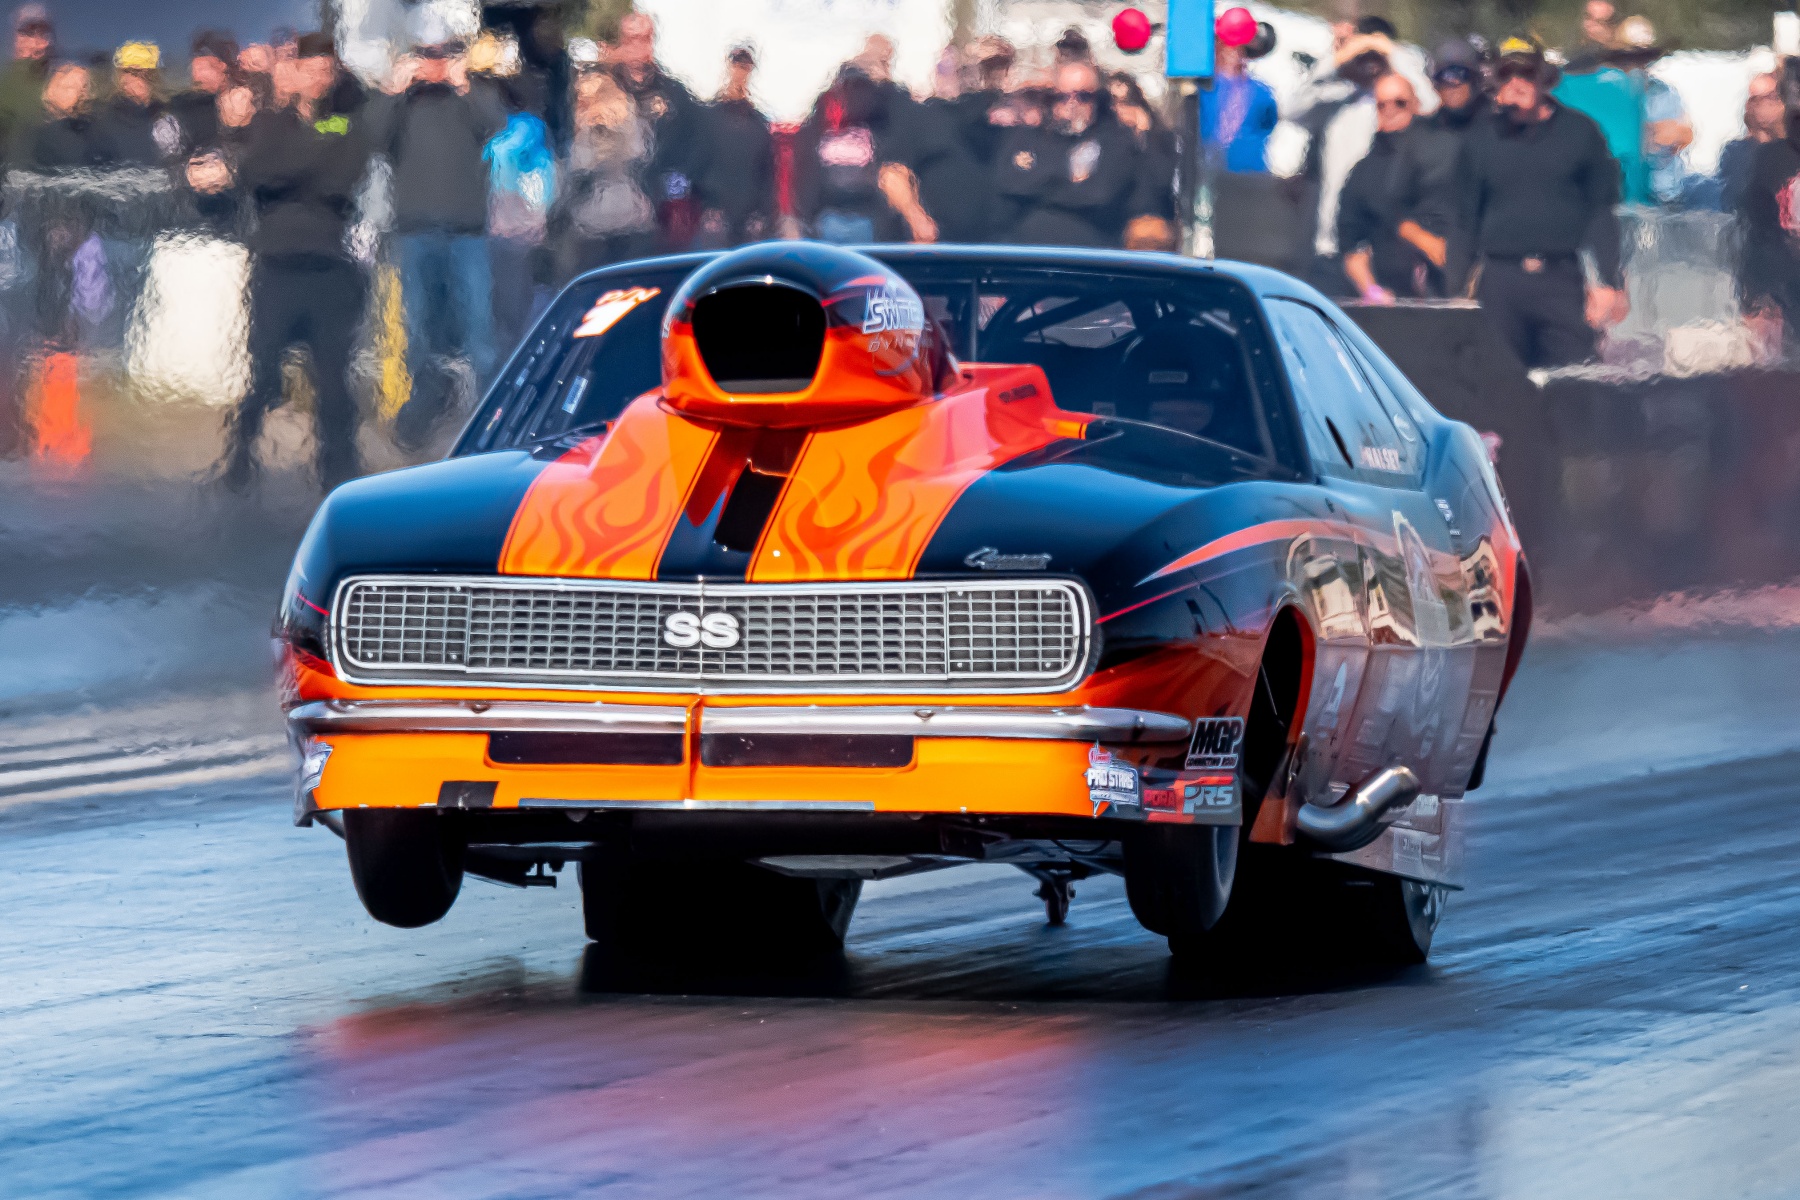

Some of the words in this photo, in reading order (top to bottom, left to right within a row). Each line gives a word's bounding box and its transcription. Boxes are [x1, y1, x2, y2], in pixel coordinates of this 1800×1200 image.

[663, 611, 740, 648] SS
[1191, 720, 1242, 754] MGP
[1087, 768, 1108, 787] PRO
